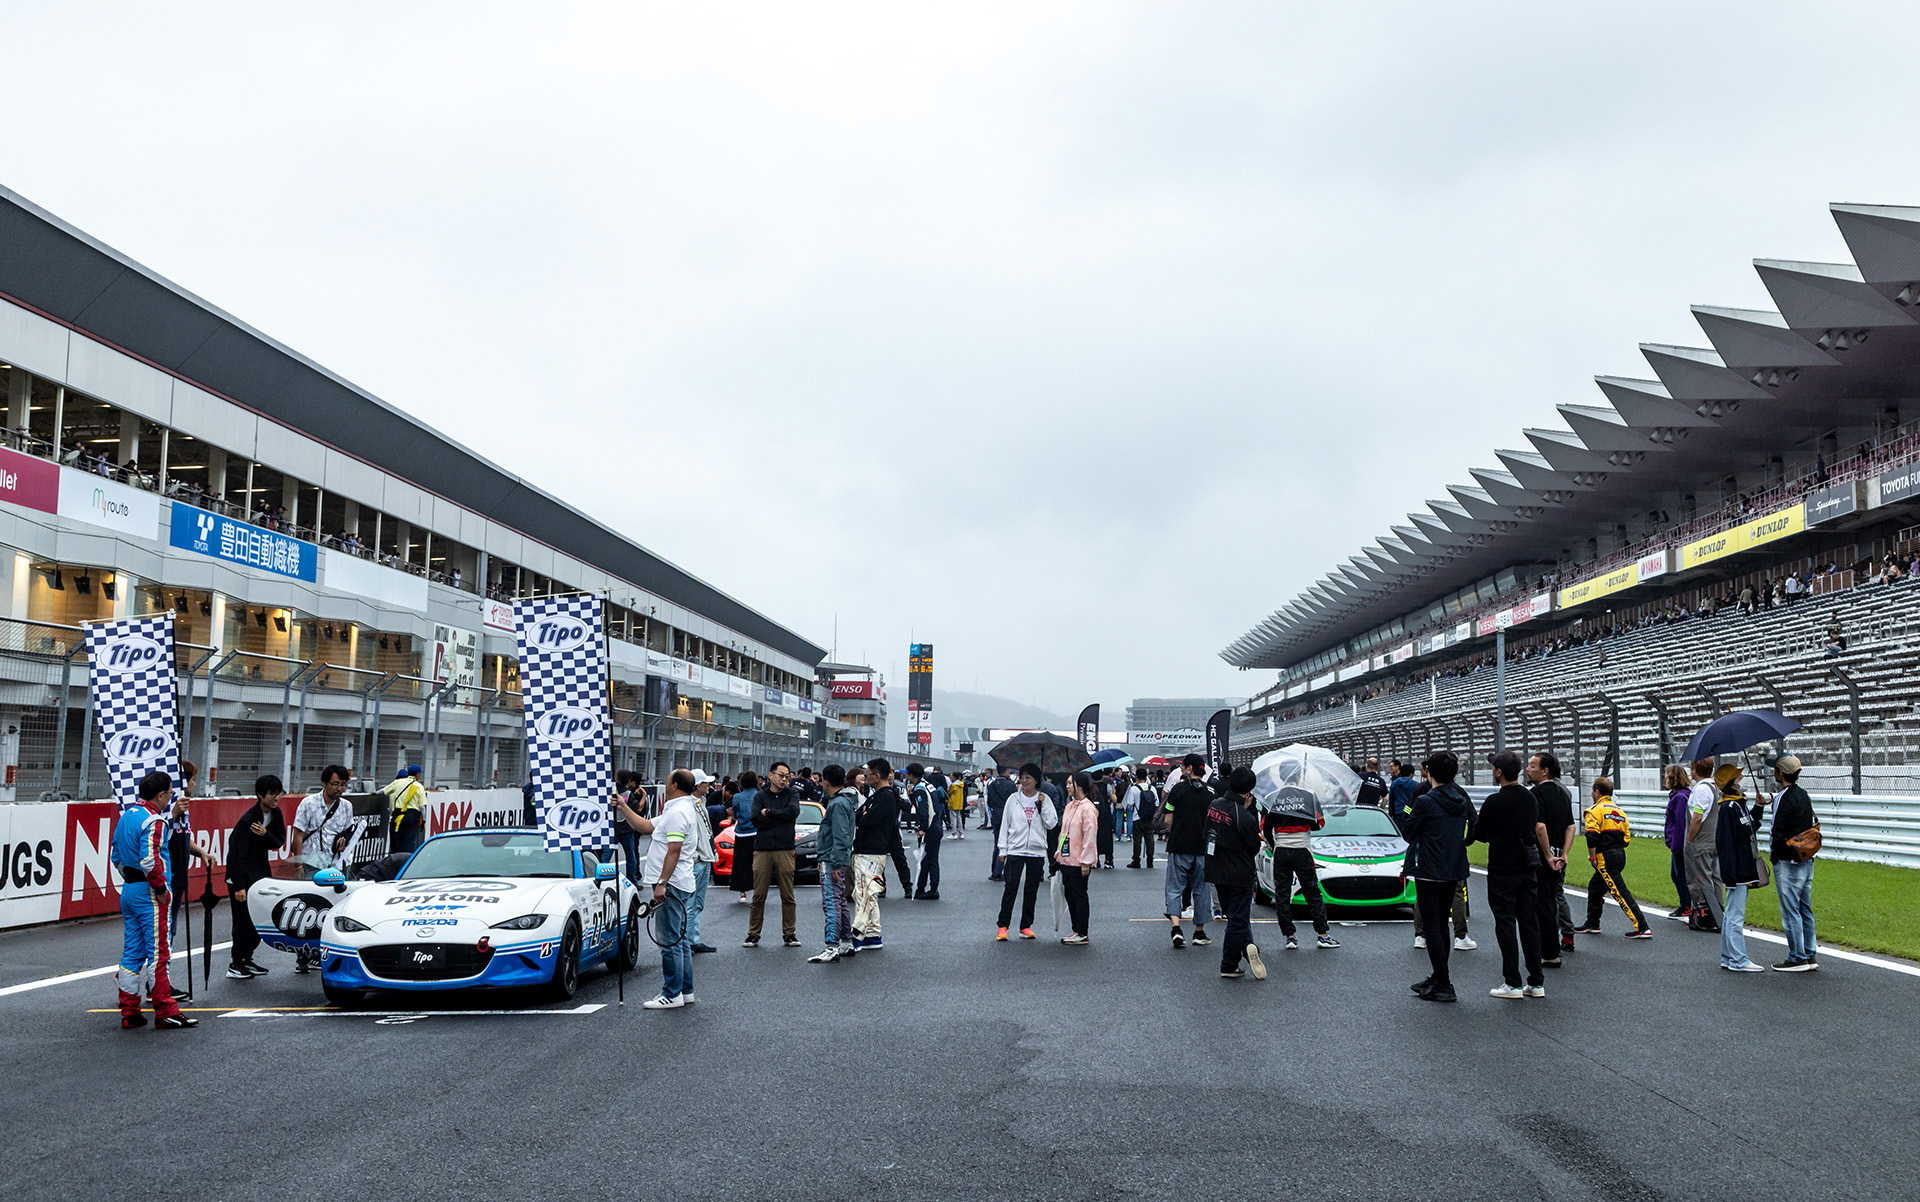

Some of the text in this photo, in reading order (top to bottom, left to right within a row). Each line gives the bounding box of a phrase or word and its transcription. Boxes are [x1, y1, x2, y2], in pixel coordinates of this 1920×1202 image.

[1882, 475, 1909, 495] TOYOTA
[107, 499, 129, 517] route
[1756, 517, 1789, 538] DUNLOP
[193, 539, 209, 552] TOYOTA
[219, 521, 300, 576] 豊田自動織機
[1698, 538, 1727, 558] DUNLOP
[1645, 556, 1662, 575] YAMAHA
[1608, 572, 1629, 588] DUNLOP
[1571, 586, 1590, 600] DUNLOP
[538, 624, 584, 647] Tipo
[109, 643, 156, 669] Tipo
[548, 713, 593, 738] Tipo
[118, 732, 165, 759] Tipo
[1210, 738, 1220, 781] GALLERY
[368, 814, 381, 827] PLUG
[430, 800, 473, 838] NGK
[474, 808, 506, 827] SPARK
[558, 805, 600, 830] Tipo
[384, 893, 501, 906] Daytona
[401, 918, 459, 927] mazda
[412, 951, 433, 963] Tipo
